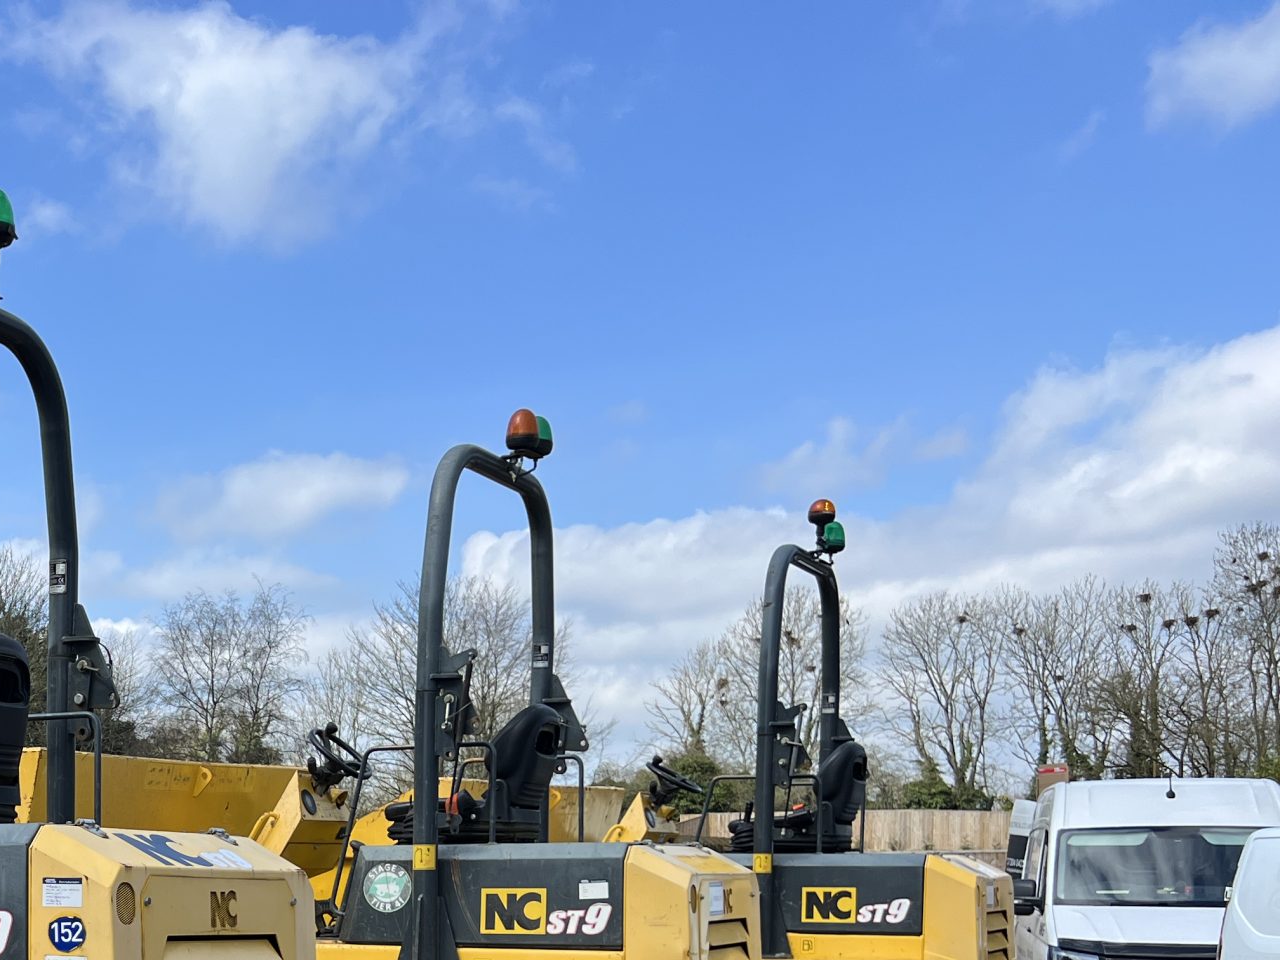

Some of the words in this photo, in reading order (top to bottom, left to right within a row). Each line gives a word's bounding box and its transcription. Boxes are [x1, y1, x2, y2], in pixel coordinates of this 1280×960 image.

[369, 863, 397, 879] STAGE
[210, 890, 238, 928] NC
[371, 897, 392, 911] TIER
[485, 892, 542, 931] NC
[547, 903, 612, 935] ST9
[805, 891, 852, 919] NC
[857, 898, 910, 923] ST9
[51, 921, 83, 943] 152
